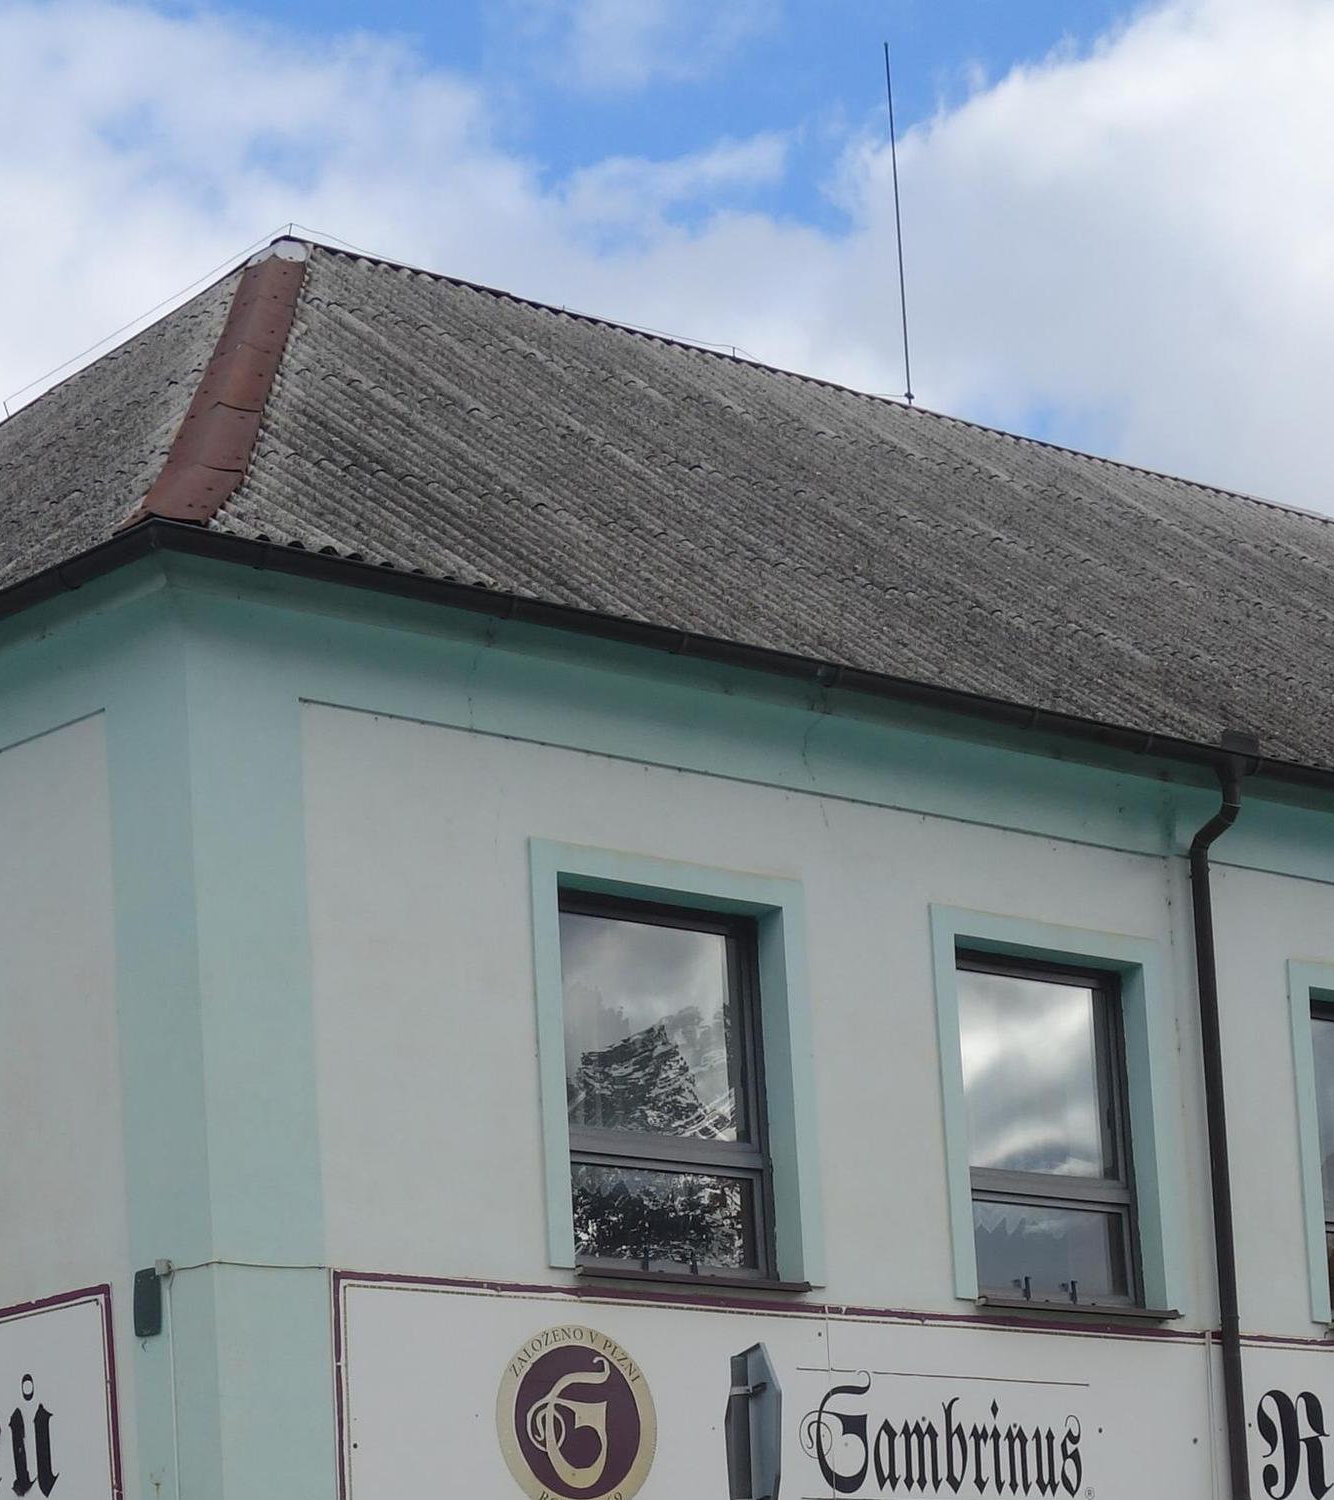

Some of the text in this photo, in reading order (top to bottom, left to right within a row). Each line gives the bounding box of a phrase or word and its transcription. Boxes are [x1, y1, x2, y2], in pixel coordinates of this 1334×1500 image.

[509, 1326, 585, 1379] ZALOŽENO
[603, 1339, 641, 1383] PLZNI
[799, 1370, 1083, 1498] Gambrinus
